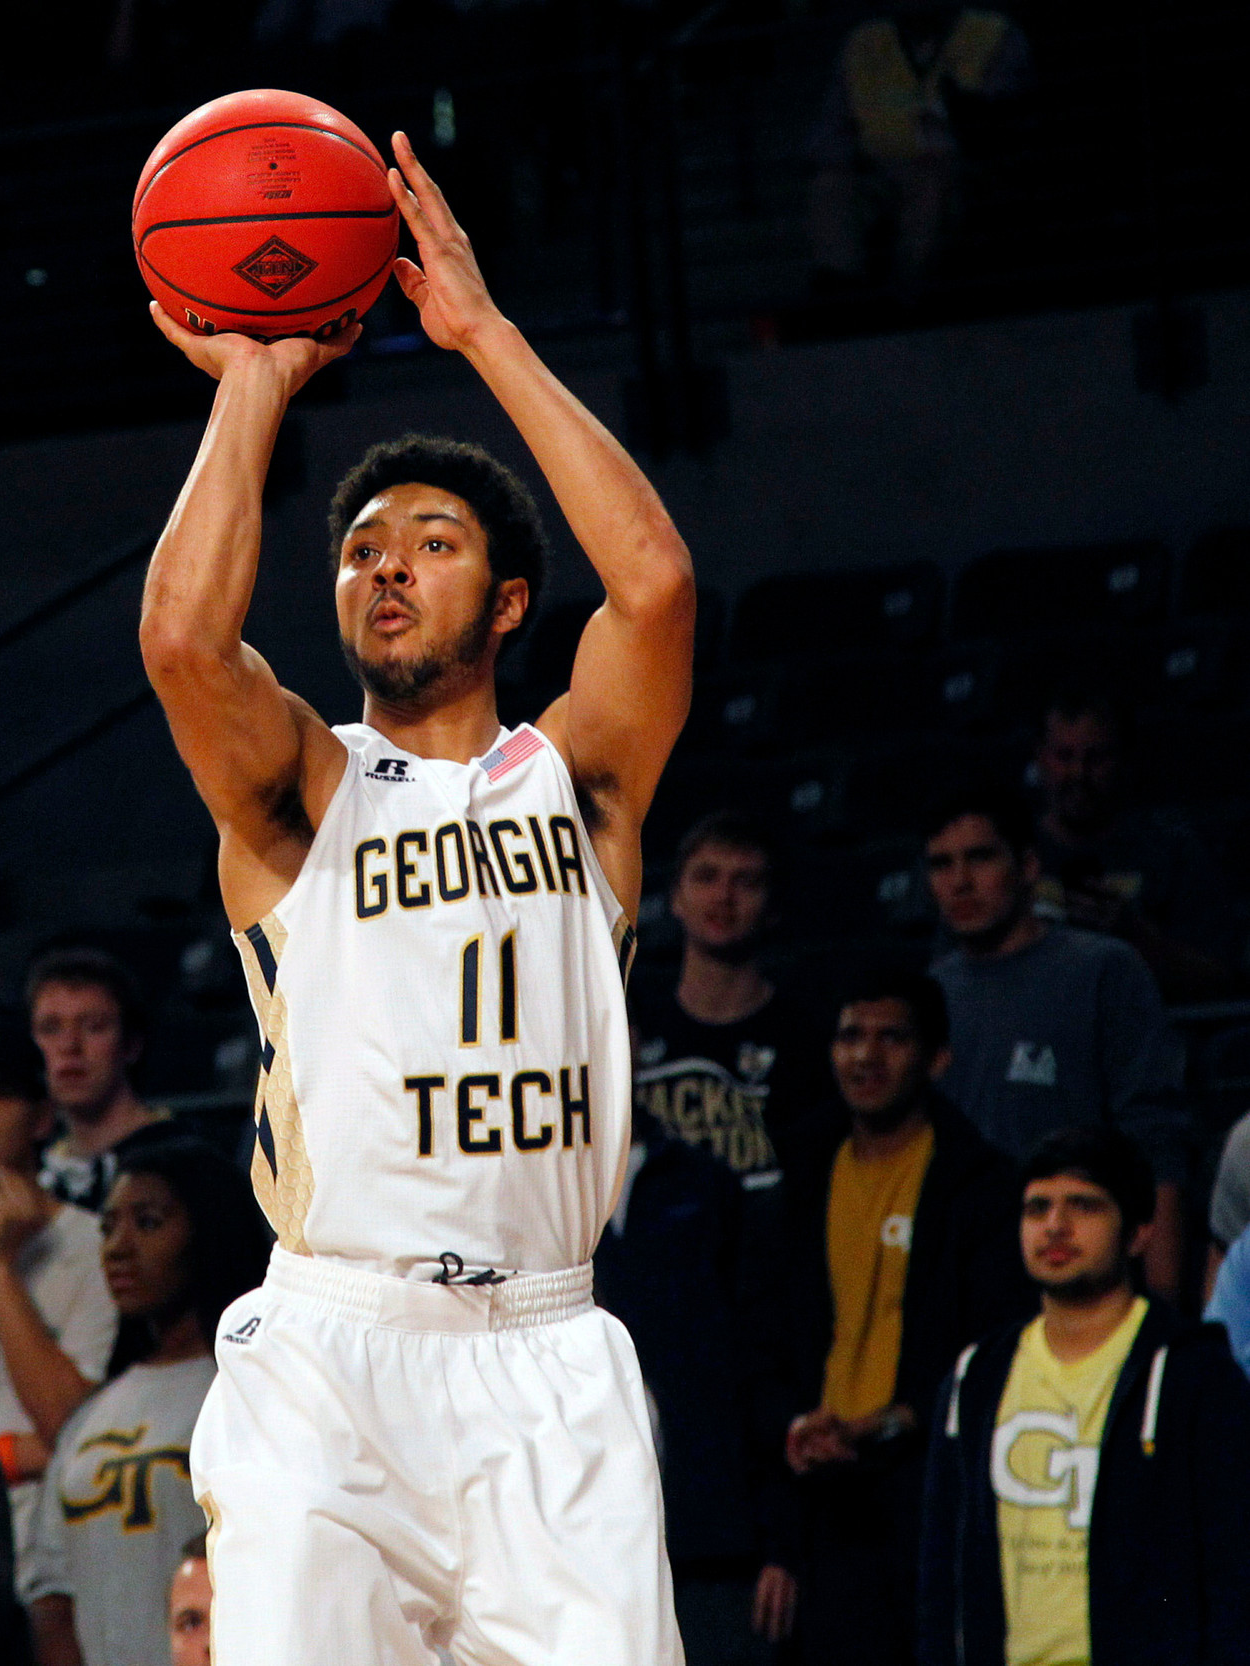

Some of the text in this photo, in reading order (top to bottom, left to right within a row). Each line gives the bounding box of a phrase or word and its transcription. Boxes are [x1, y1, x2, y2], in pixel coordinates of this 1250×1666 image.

[354, 814, 590, 922] GEORGIA
[459, 929, 521, 1048] 11
[402, 1064, 592, 1160] TECH
[989, 1410, 1100, 1529] GT
